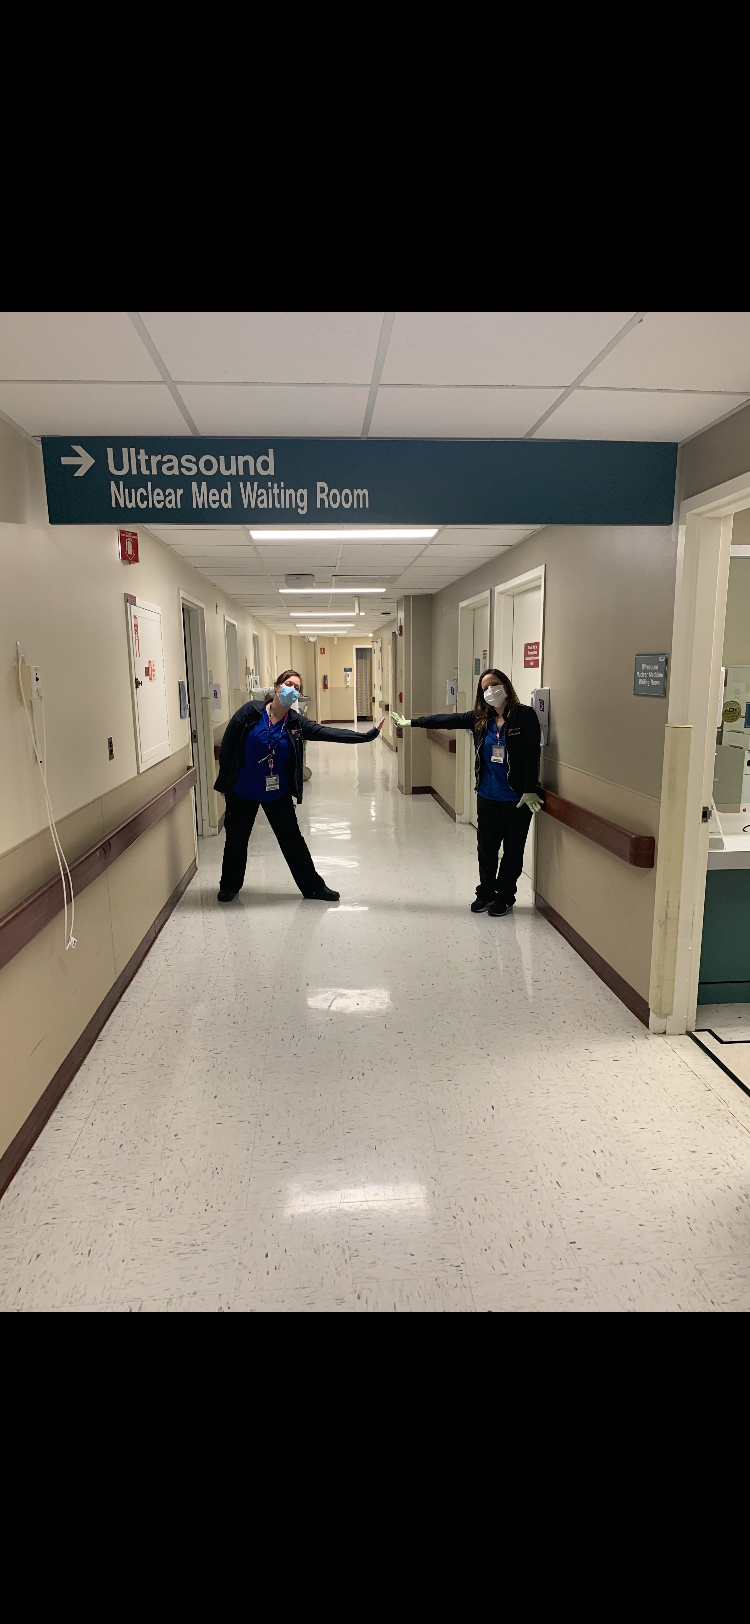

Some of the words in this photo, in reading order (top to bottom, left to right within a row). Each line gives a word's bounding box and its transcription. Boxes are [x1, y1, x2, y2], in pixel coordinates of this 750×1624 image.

[107, 447, 275, 476] Ultrasound
[110, 481, 183, 508] Nuclear
[191, 481, 232, 509] Med
[239, 481, 308, 515] Waiting
[316, 481, 369, 509] Room
